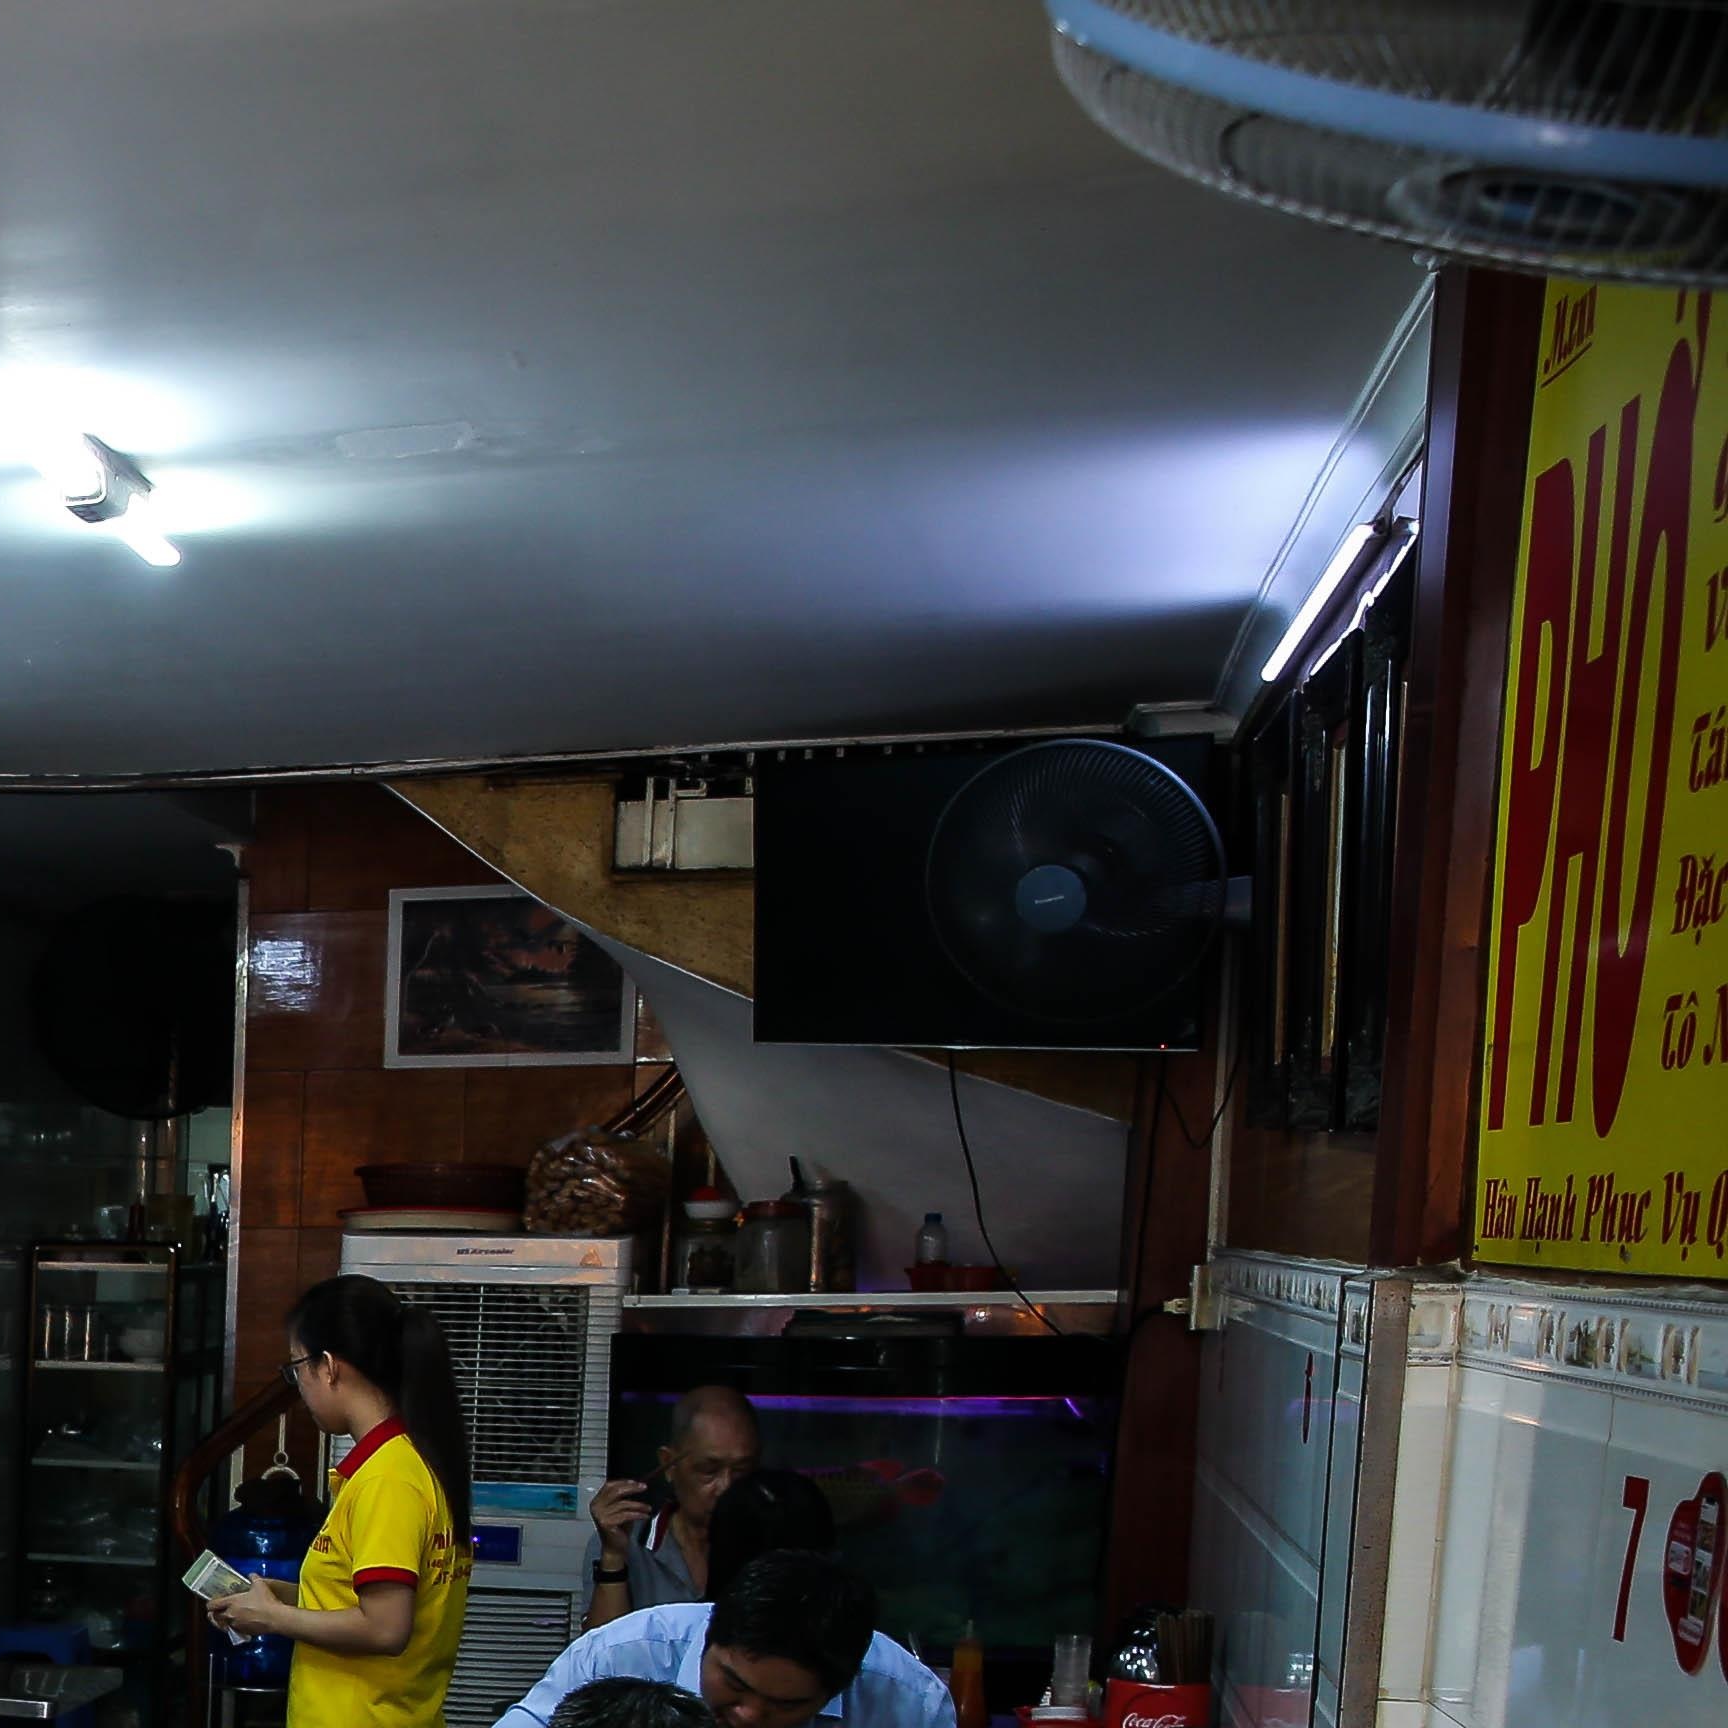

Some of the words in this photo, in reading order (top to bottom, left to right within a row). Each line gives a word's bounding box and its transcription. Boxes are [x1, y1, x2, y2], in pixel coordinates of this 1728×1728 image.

[1481, 1177, 1517, 1240] Hân
[1519, 1174, 1576, 1254] Hạnh
[1580, 1170, 1652, 1257] Phục
[1661, 1170, 1703, 1261] Vụ
[1613, 1475, 1650, 1643] 7
